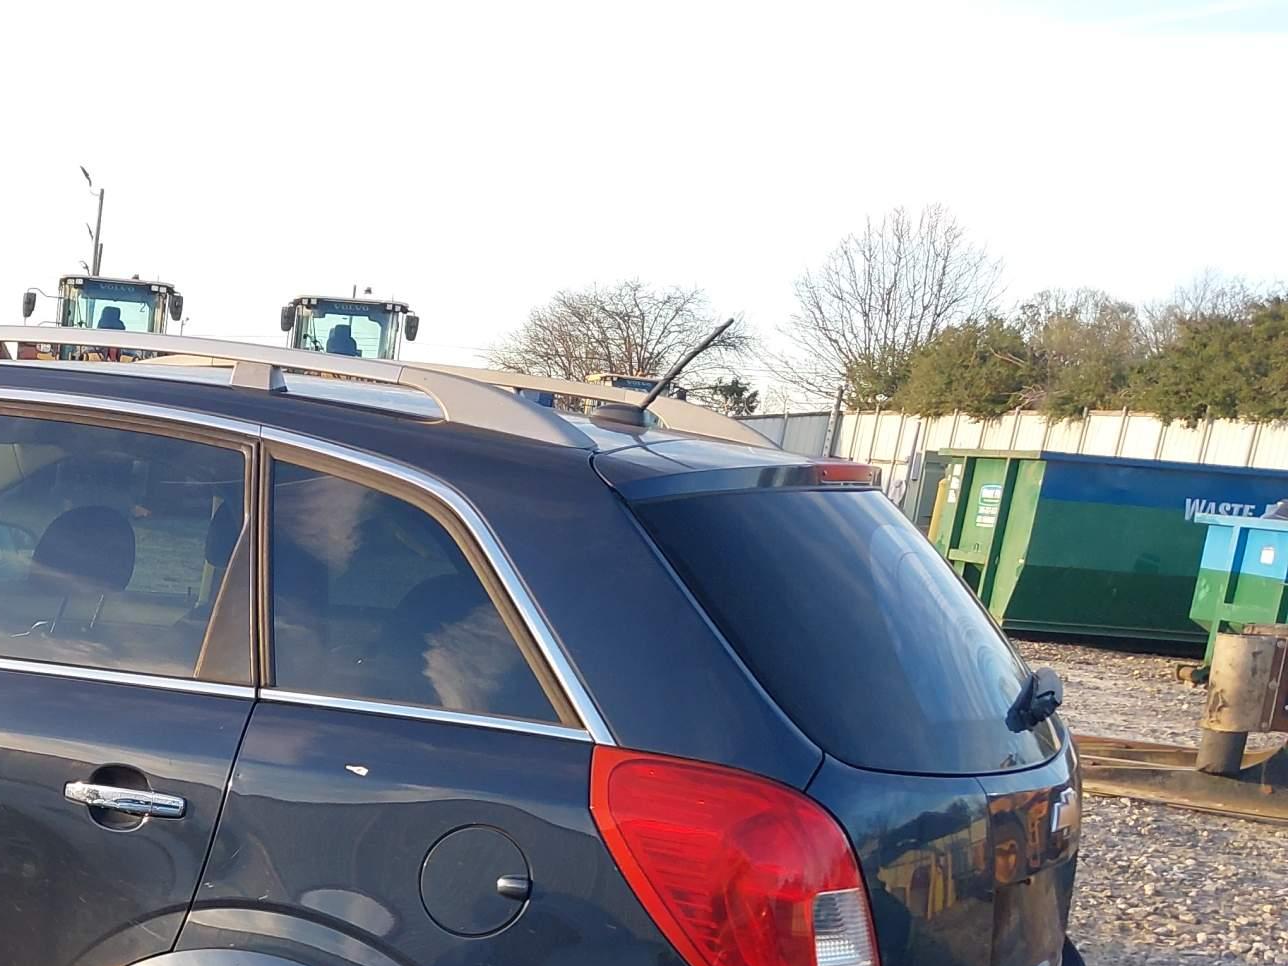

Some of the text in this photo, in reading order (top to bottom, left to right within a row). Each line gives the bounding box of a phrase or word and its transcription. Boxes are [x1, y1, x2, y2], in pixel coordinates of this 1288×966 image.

[100, 283, 135, 292] VOLVO
[334, 303, 369, 311] VOLVO
[1185, 498, 1256, 520] WASTE
